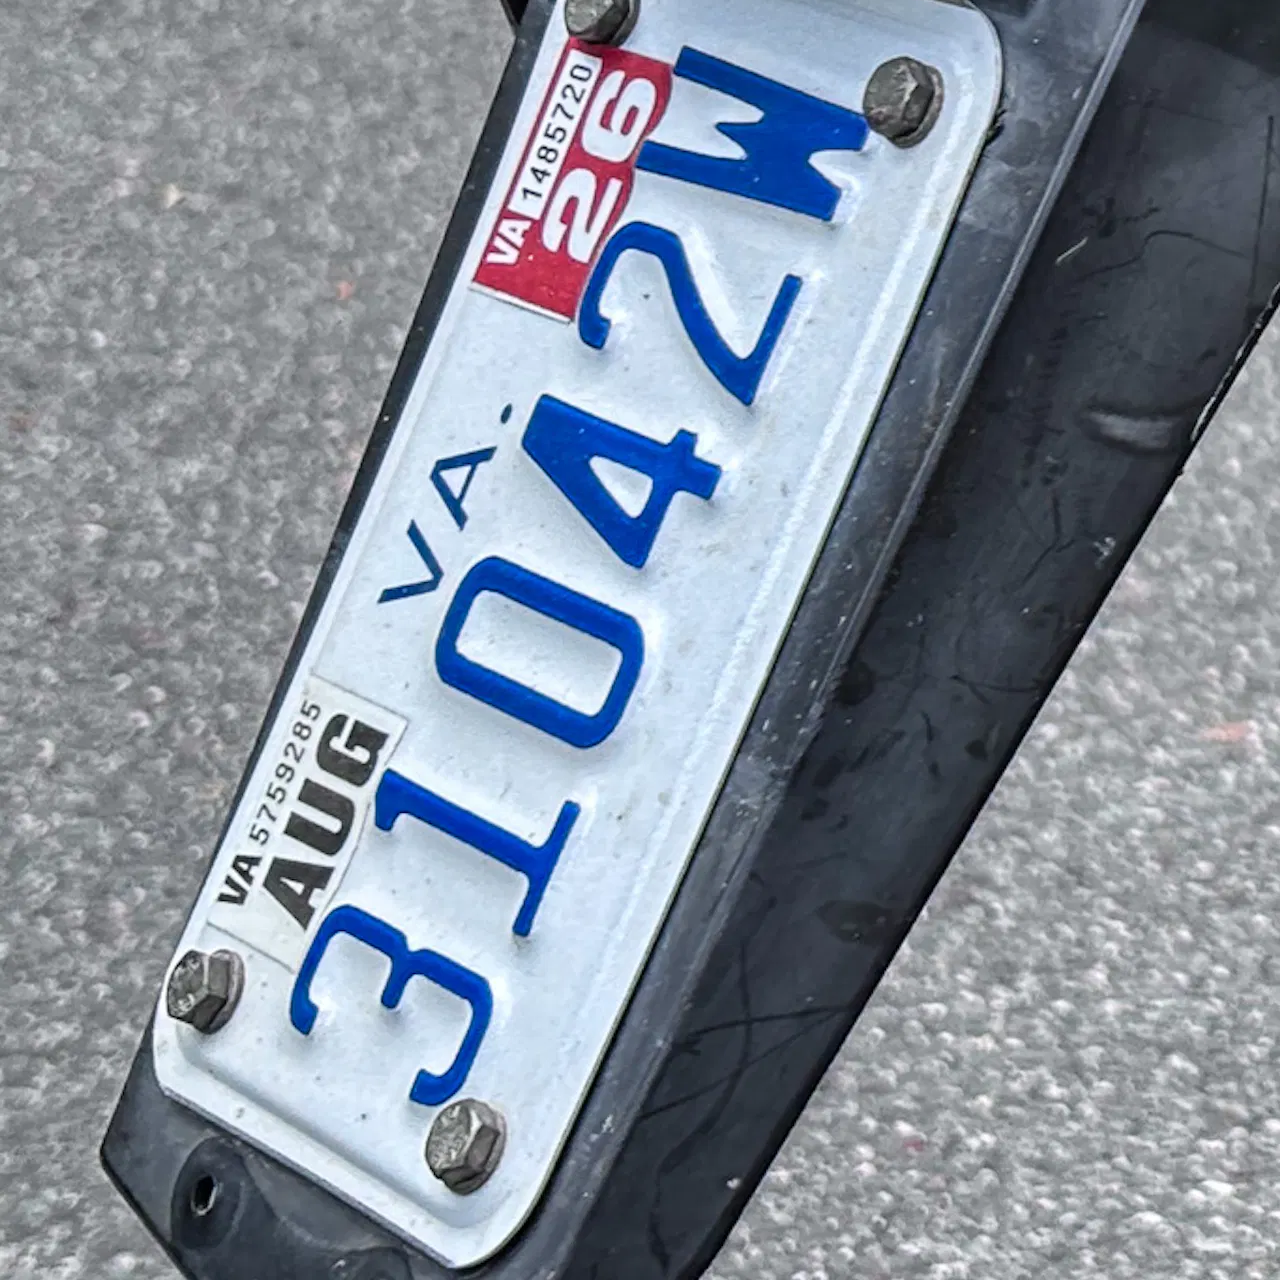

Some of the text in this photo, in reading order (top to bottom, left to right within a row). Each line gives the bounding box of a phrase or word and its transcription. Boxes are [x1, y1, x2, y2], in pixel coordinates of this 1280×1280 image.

[486, 63, 593, 266] VA 1485720
[541, 69, 657, 264] 26
[289, 46, 871, 1107] 31042W
[217, 699, 321, 906] VA 5759285
[262, 713, 390, 931] AUG
